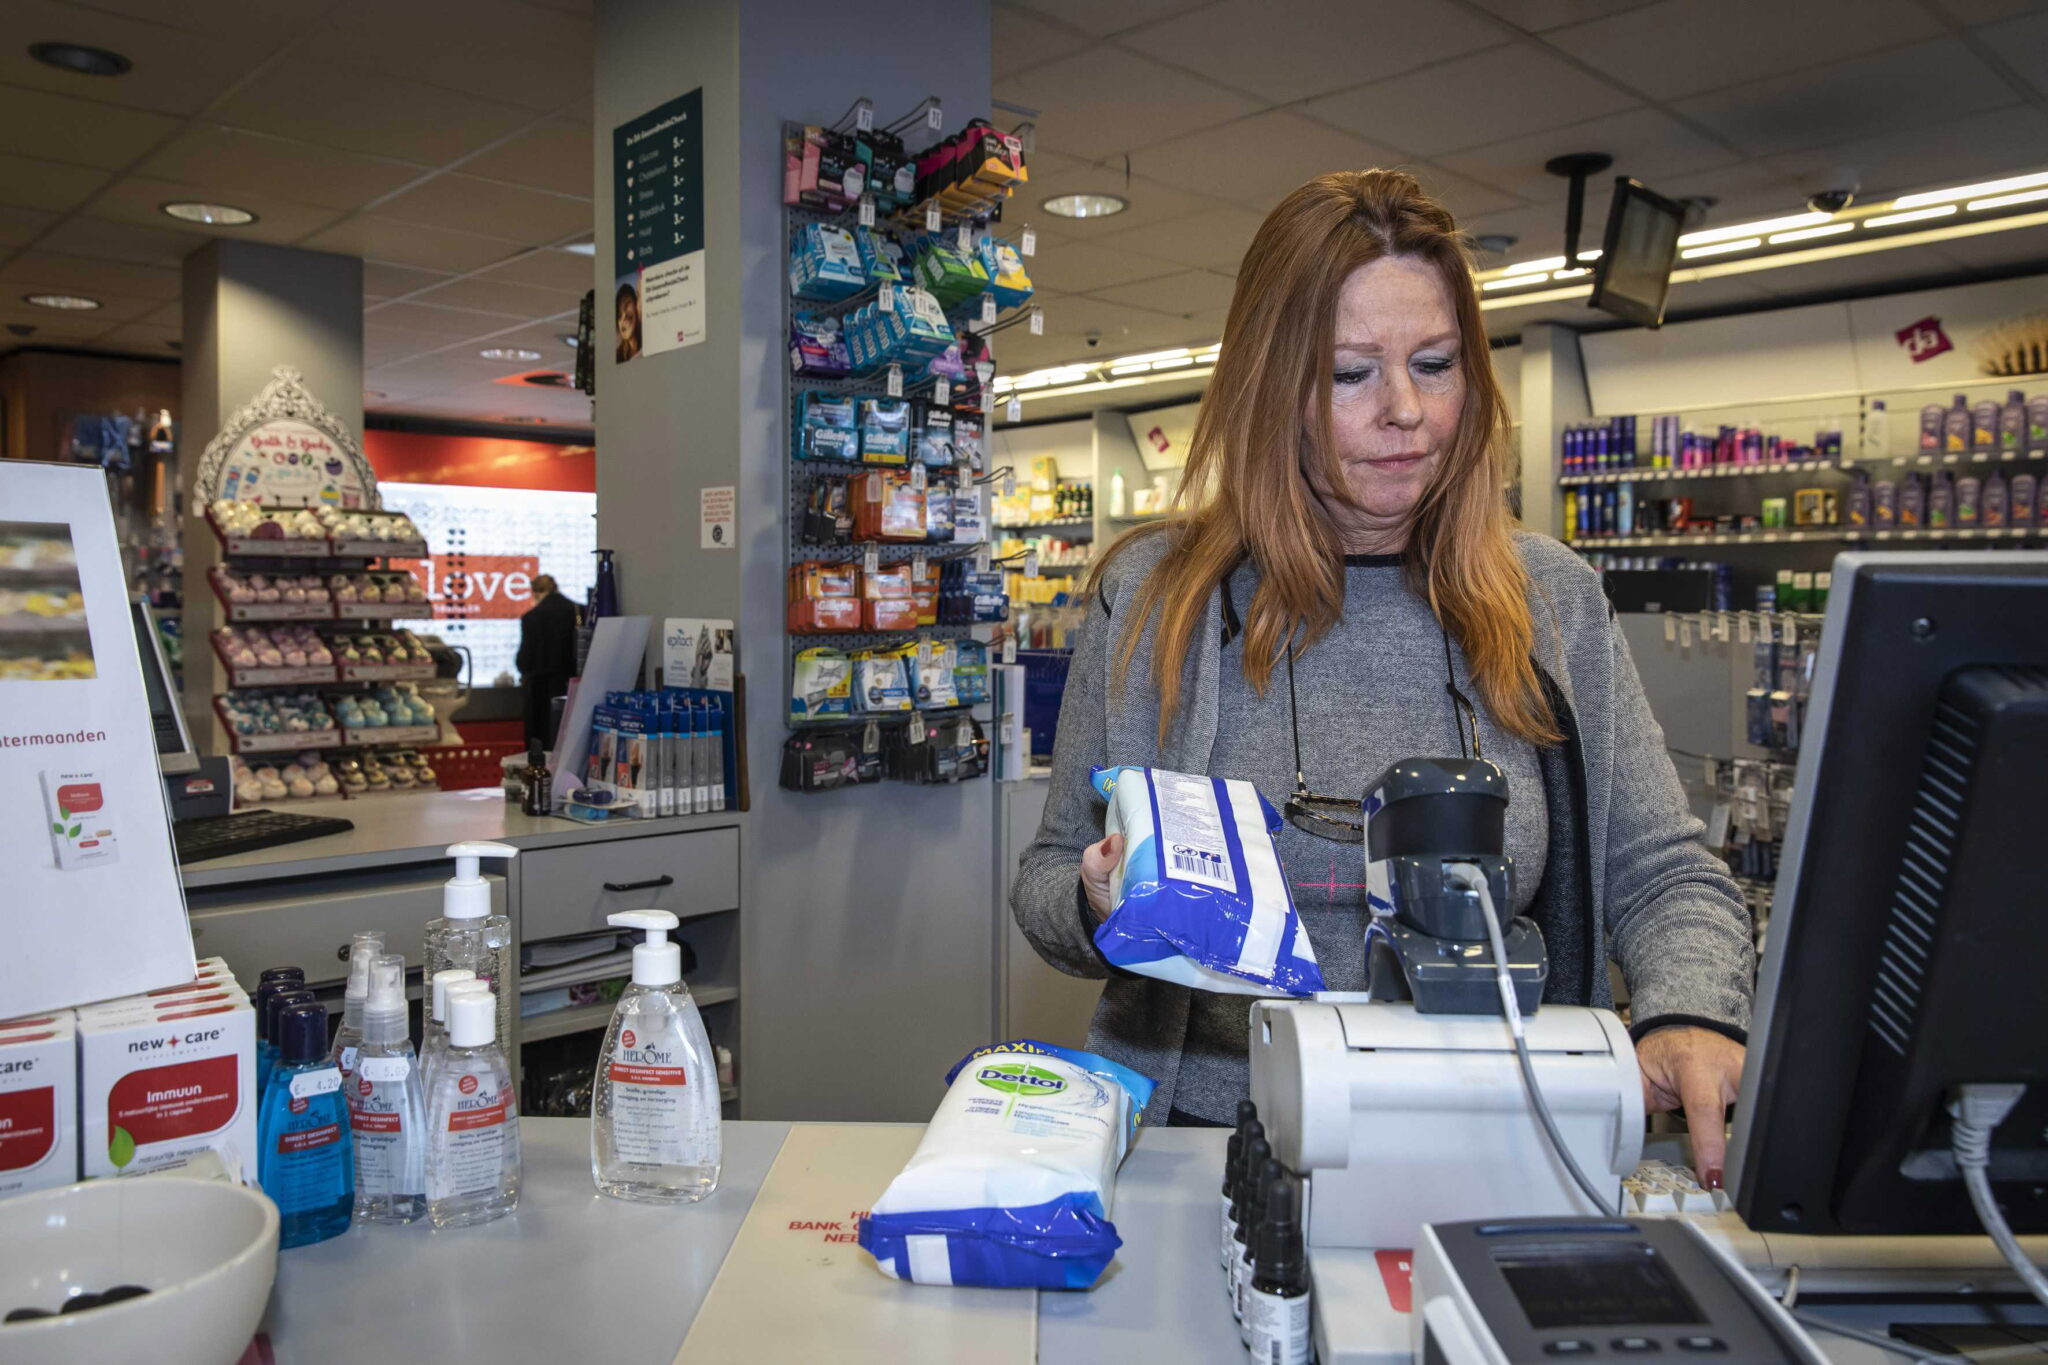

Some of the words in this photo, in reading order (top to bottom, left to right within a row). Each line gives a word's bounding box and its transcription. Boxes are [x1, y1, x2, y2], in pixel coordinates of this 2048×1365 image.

[815, 429, 850, 442] Gillette
[866, 434, 900, 445] Gillette
[420, 560, 532, 602] love
[818, 600, 854, 612] Gillette
[0, 729, 106, 748] termaanden
[128, 1037, 164, 1054] new
[184, 1028, 220, 1044] care
[973, 1042, 1034, 1059] MAXI
[316, 1077, 339, 1091] 4.20
[980, 1069, 1064, 1090] Dettol
[147, 1084, 202, 1104] Immuun
